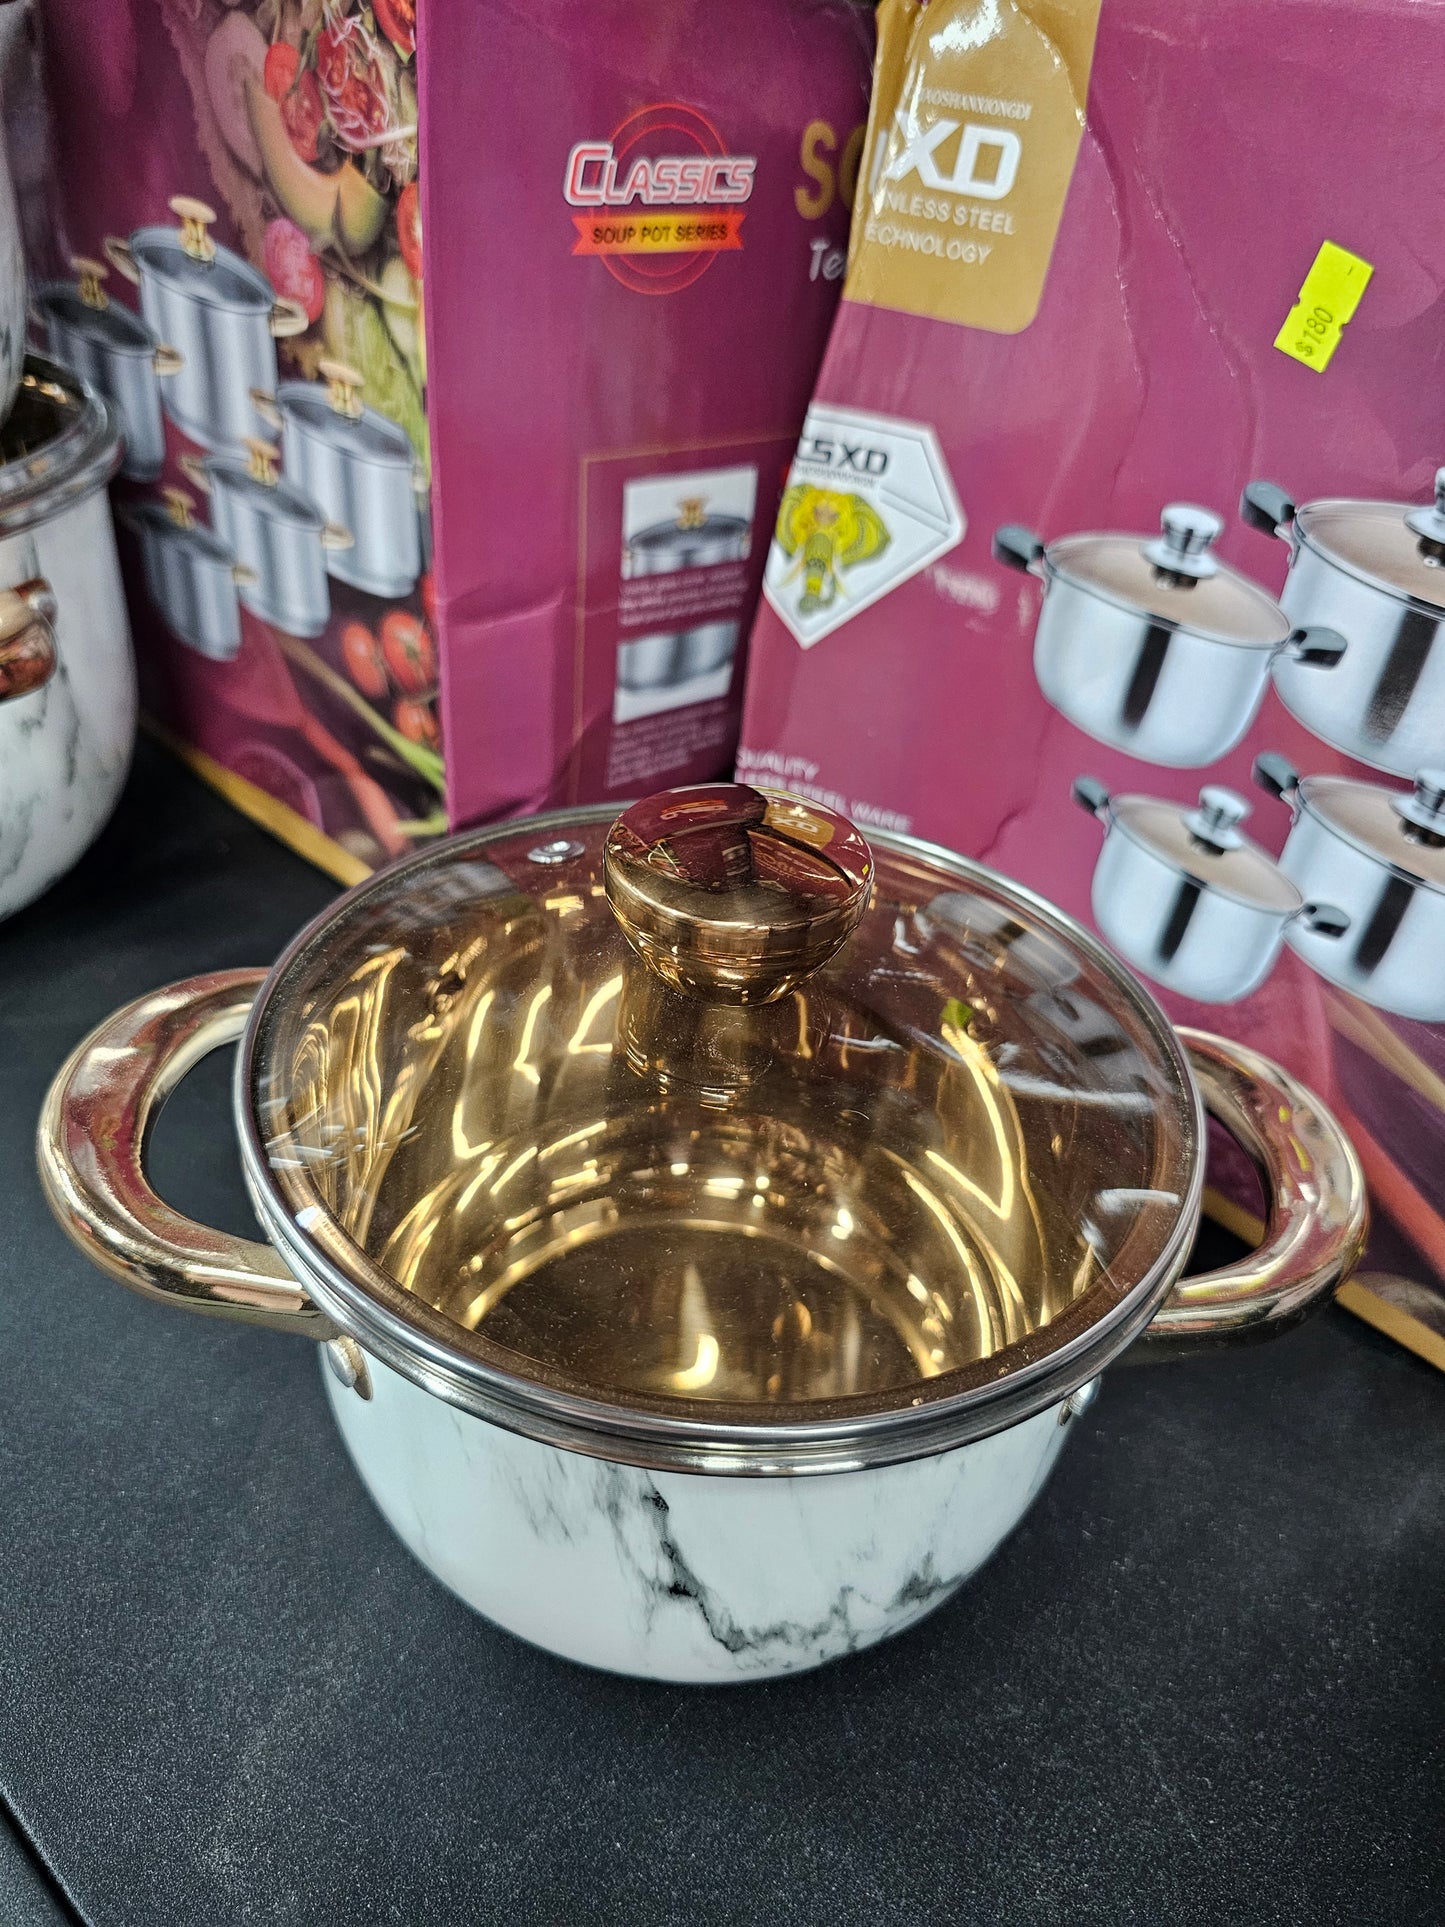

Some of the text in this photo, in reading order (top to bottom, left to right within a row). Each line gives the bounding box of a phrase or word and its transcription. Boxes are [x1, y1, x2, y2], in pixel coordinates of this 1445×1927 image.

[565, 142, 756, 206] CLASSICS
[593, 223, 728, 244] SOUP POT SERIES
[952, 204, 1016, 236] STEEL
[1295, 307, 1333, 357] $180
[852, 803, 911, 832] WARE
